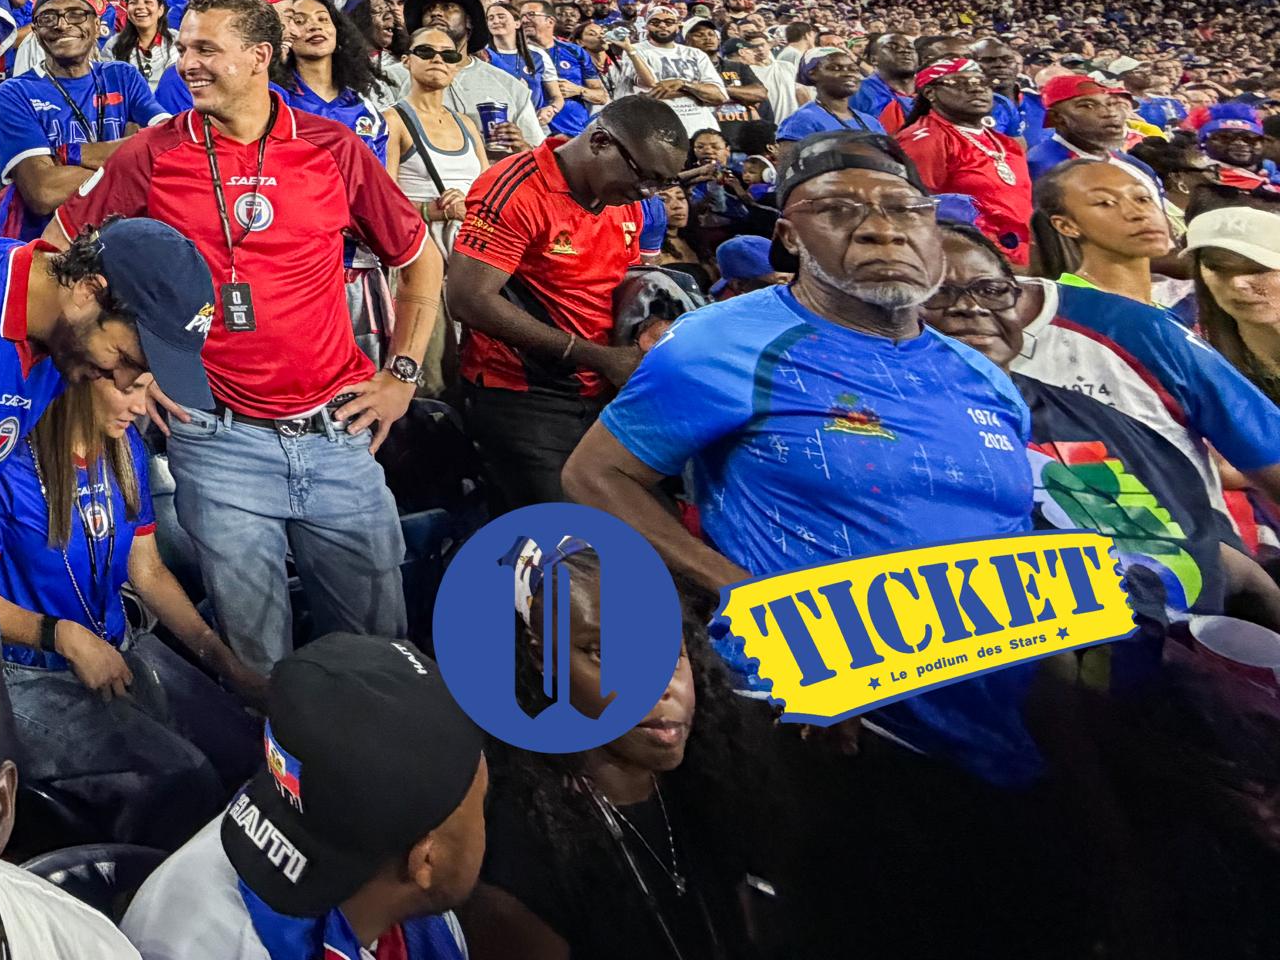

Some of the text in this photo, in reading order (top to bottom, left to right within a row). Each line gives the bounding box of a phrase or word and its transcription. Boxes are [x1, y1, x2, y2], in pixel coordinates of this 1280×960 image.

[225, 176, 278, 186] SAETA
[967, 407, 1002, 428] 1974
[228, 793, 308, 883] HAITI
